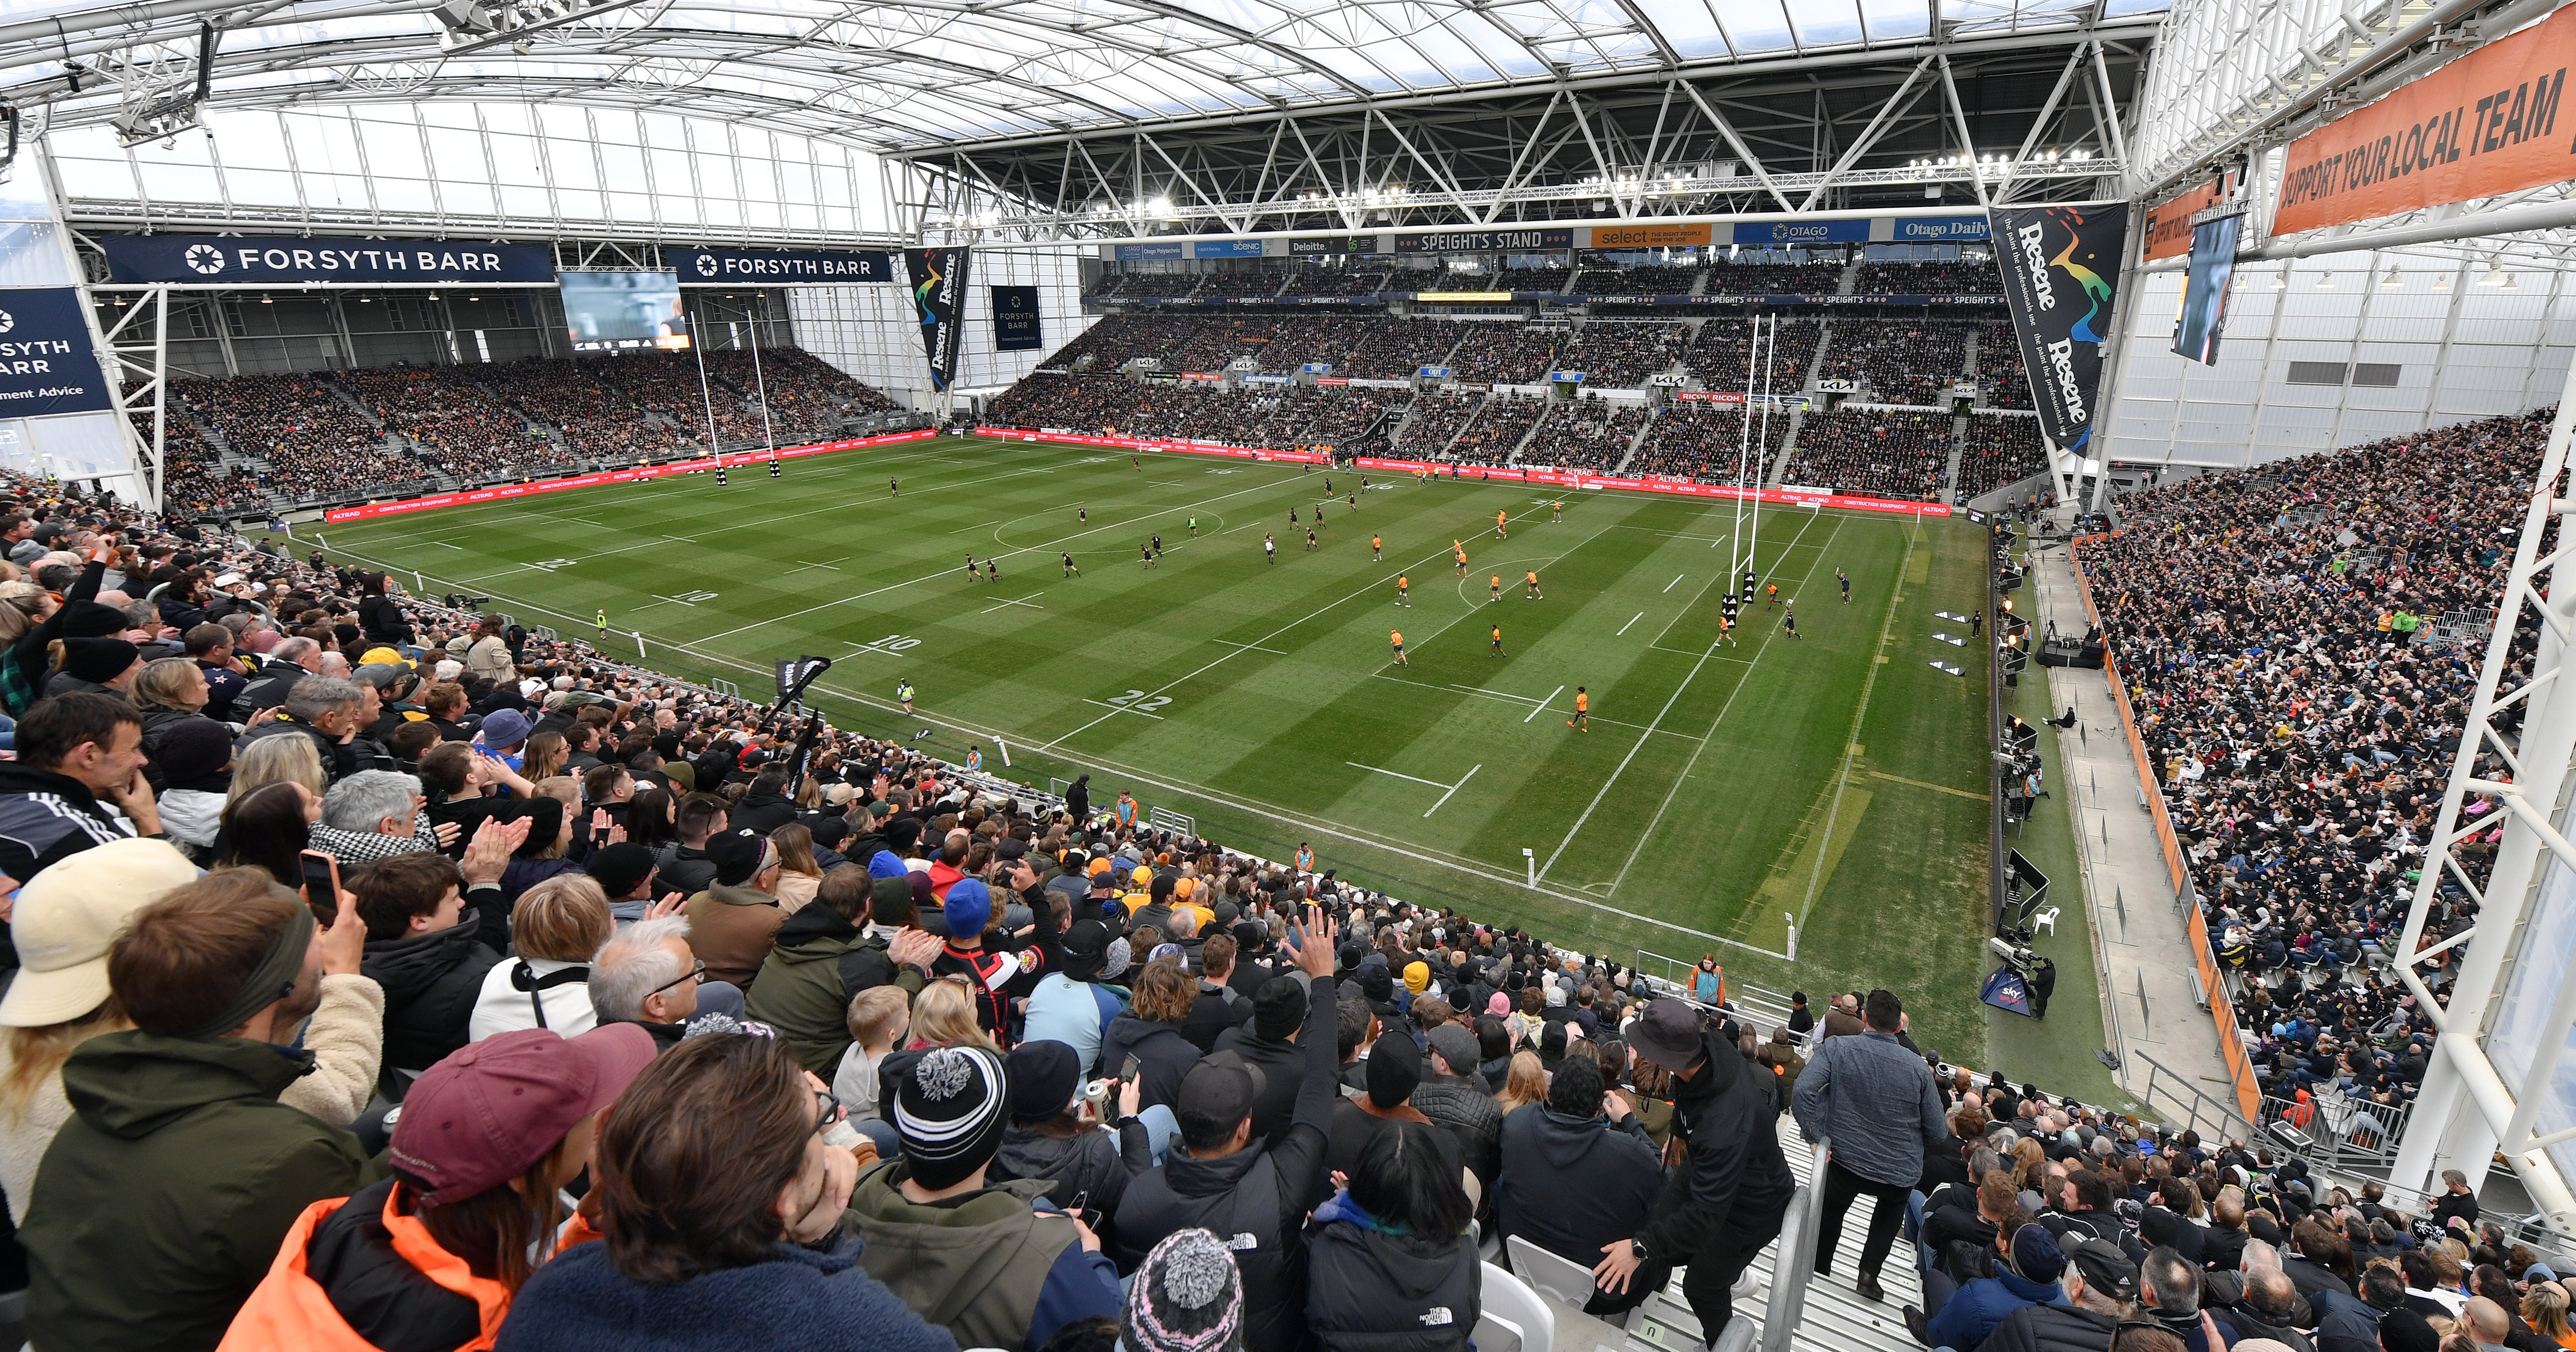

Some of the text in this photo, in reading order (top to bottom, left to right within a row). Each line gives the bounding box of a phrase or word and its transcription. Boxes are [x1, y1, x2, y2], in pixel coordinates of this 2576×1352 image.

[2281, 68, 2567, 210] SUPPORT YOUR LOCAL TEAM
[1602, 229, 1647, 243] select
[1790, 226, 1828, 236] OTAGO
[1906, 222, 1988, 238] Otago Daily
[1293, 242, 1327, 251] Deloitte.
[1422, 231, 1542, 251] SPEIGHT'S STAND
[238, 248, 502, 272] FORSYTH BARR
[724, 257, 872, 275] FORSYTH BARR
[2018, 221, 2056, 311] Resene
[939, 253, 956, 306] Resene
[2006, 232, 2017, 253] paint
[2014, 264, 2034, 313] professionals
[2028, 312, 2036, 327] use
[1710, 296, 1745, 304] SPEIGHT'S
[1826, 296, 1864, 304] SPEIGHT'S
[1954, 296, 1995, 304] SPEIGHT'S
[0, 340, 71, 356] SYTH
[932, 321, 947, 371] Resene
[0, 360, 51, 375] ARR
[1428, 368, 1443, 377] ODT
[1560, 373, 1577, 381] ODT
[1655, 375, 1685, 385] KIA
[2033, 333, 2065, 425] the paint the professionals
[2047, 337, 2087, 423] Resene
[38, 386, 84, 397] Advice
[1821, 381, 1854, 390] KIA
[539, 477, 600, 490] CONSTRUCTION EQUIPMENT
[1658, 476, 1689, 484] ALTRAD
[501, 487, 524, 496] ALTRAD
[379, 497, 452, 512] CONSTRUCTION EQUIPMENT
[333, 511, 360, 520] ALTRAD
[536, 558, 578, 569] 22
[671, 589, 719, 602] 10
[867, 634, 922, 651] 10
[1106, 689, 1174, 713] 22
[2002, 986, 2021, 999] sky
[1419, 1312, 1442, 1321] NORTH
